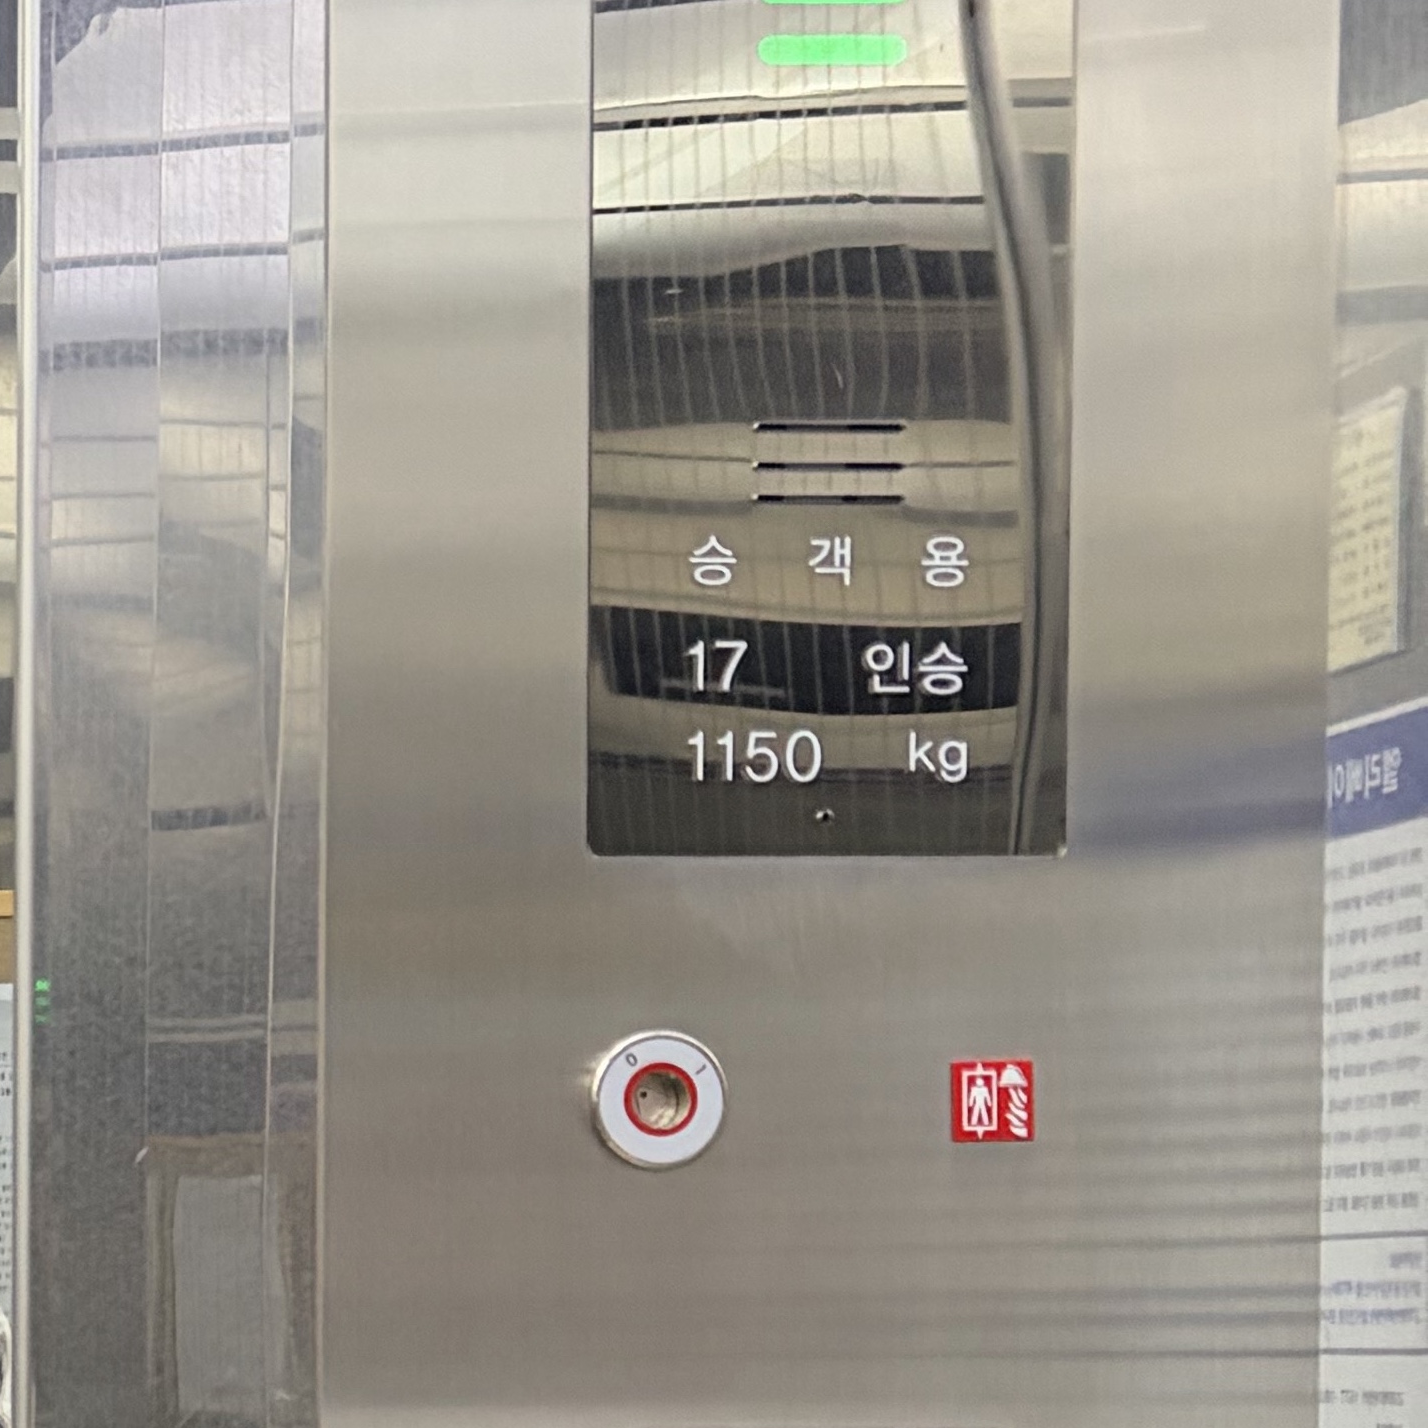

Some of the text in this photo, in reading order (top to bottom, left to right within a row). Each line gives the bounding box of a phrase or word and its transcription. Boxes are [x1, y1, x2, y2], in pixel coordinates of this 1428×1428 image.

[689, 535, 970, 587] 승 객 용
[685, 640, 969, 695] 17 인승
[687, 729, 969, 784] 1150 kg
